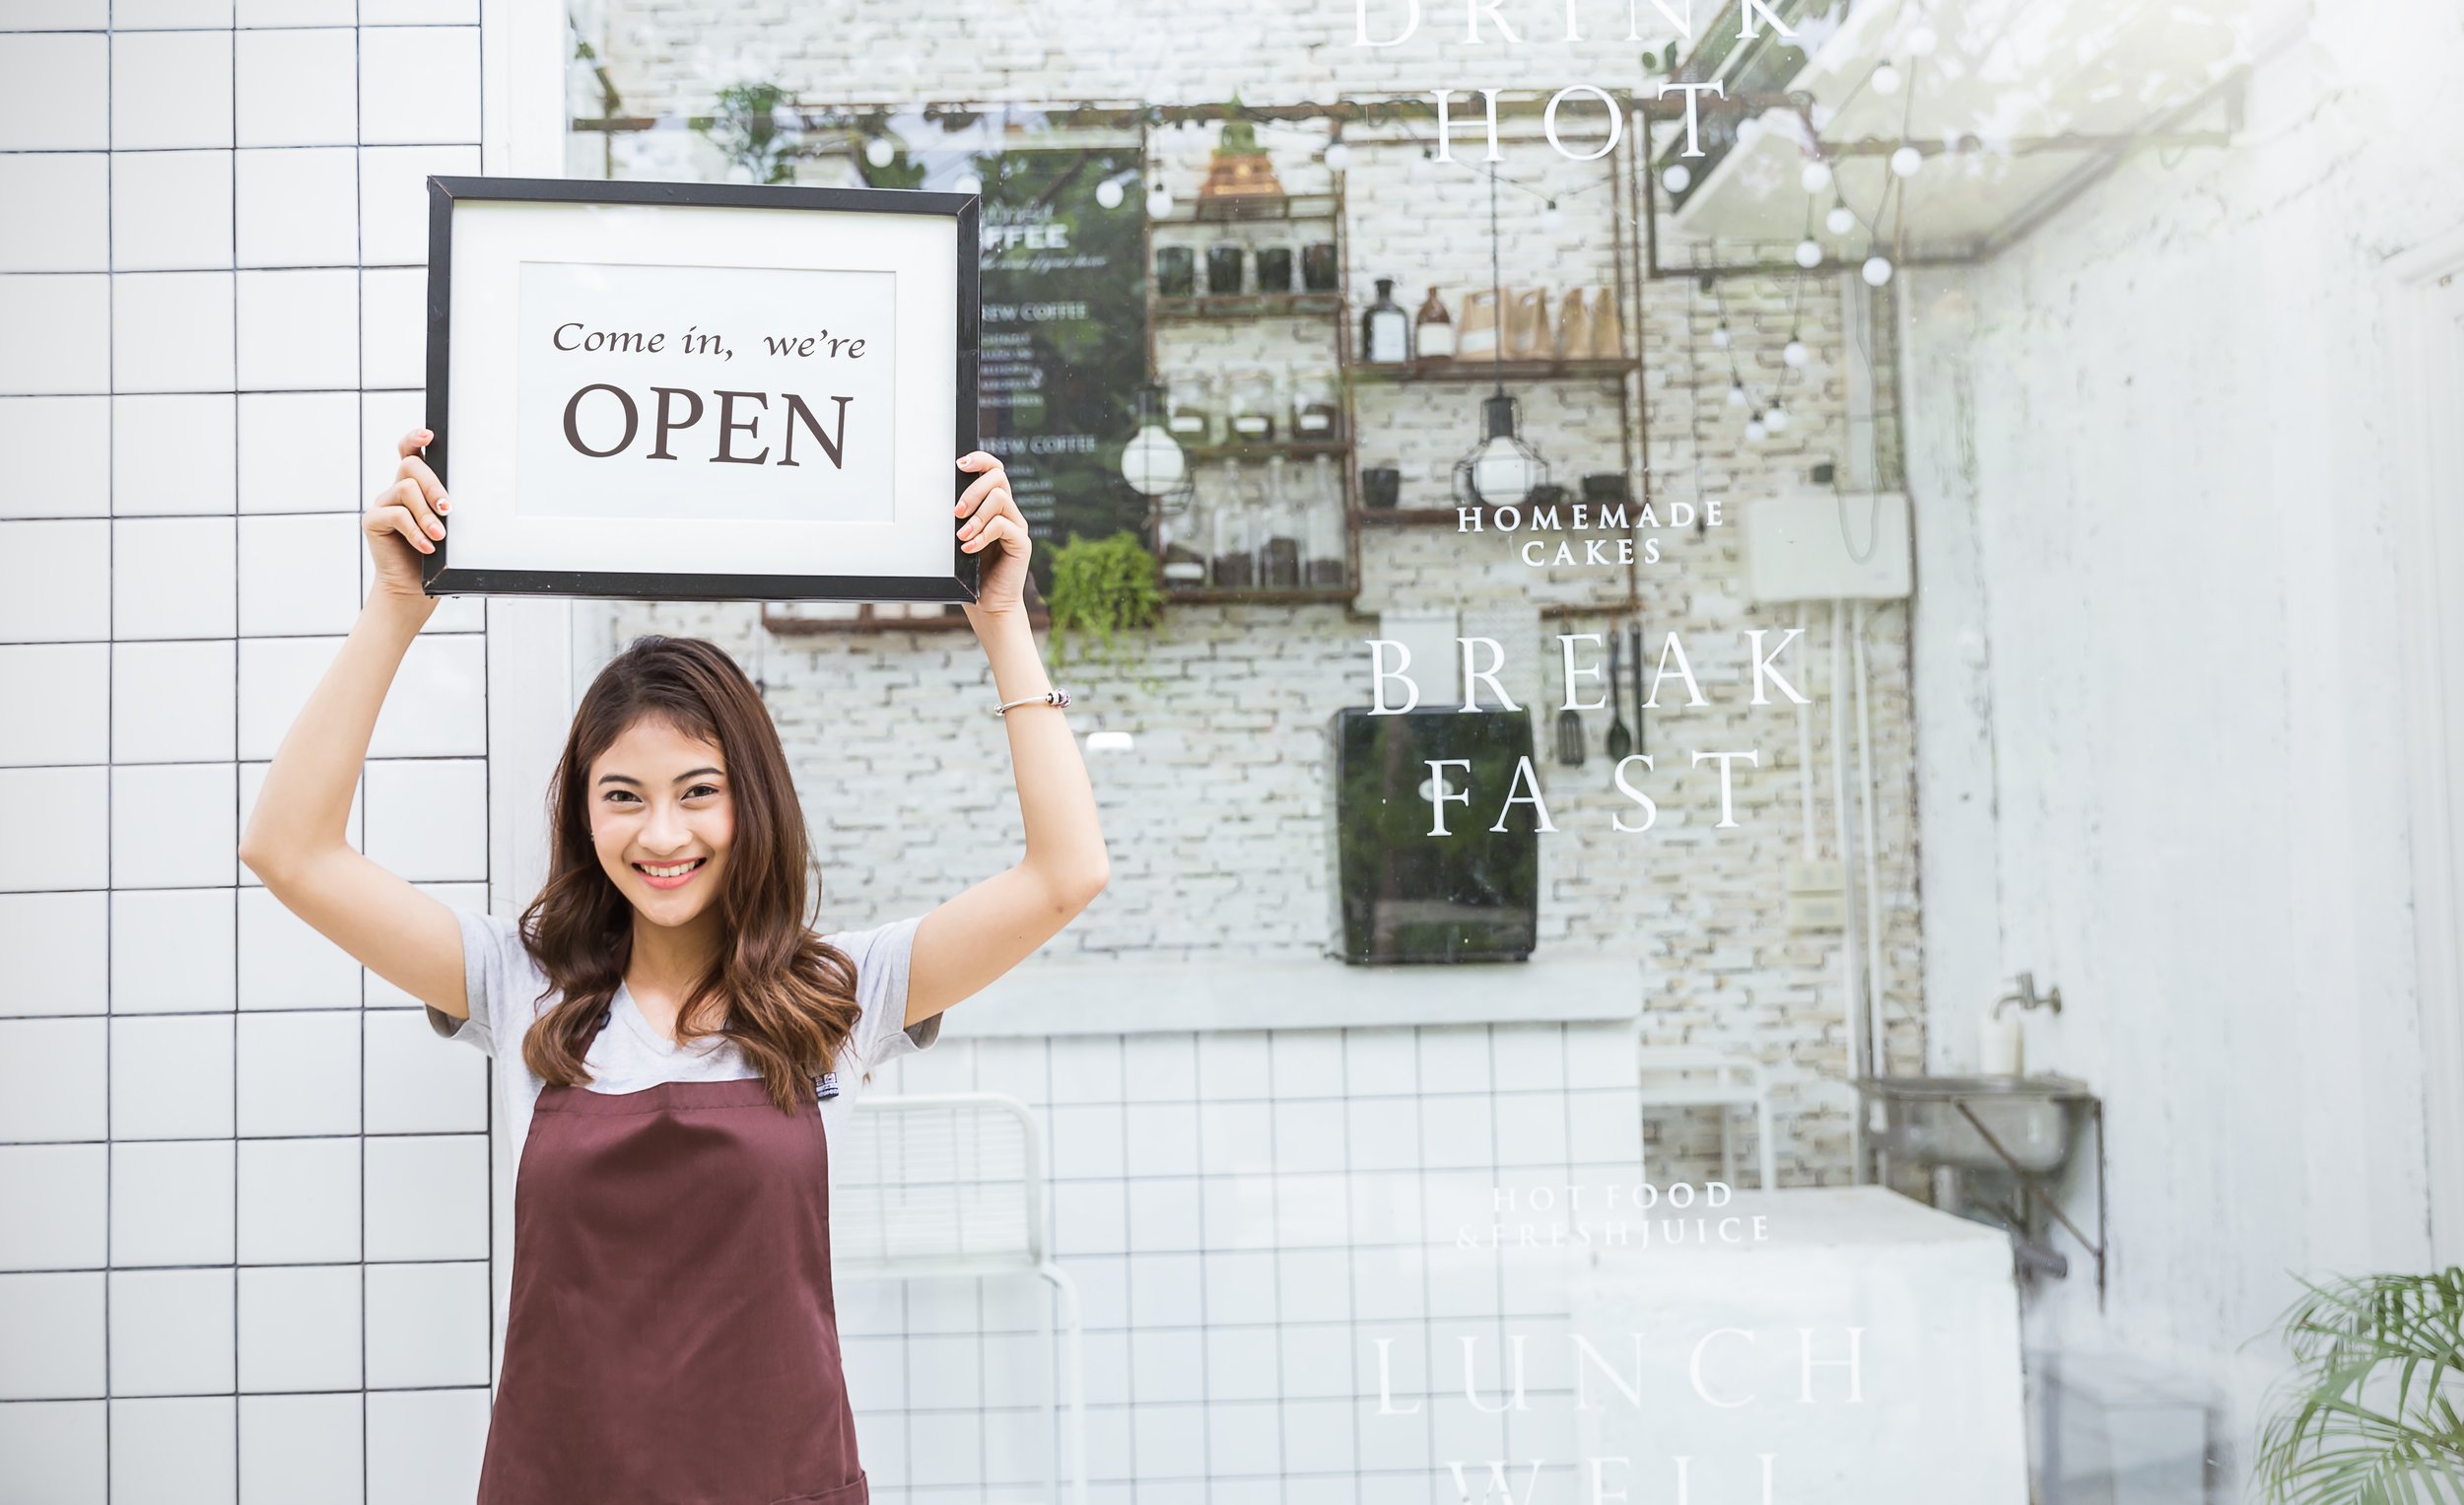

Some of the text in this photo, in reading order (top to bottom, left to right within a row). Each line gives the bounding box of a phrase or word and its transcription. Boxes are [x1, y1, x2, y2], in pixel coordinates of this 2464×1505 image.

[1351, 0, 1800, 47] DRINK
[1430, 79, 1724, 163] HOT
[552, 322, 866, 362] Come in, we're
[563, 383, 854, 469] OPEN
[1456, 501, 1724, 532] HOMEMADE
[1521, 538, 1661, 567] CAKES
[1365, 628, 1812, 716] BREAK
[1423, 749, 1759, 837] FAST
[1492, 1182, 1732, 1212] HOT FOOD
[1372, 1327, 1867, 1415] LUNCH
